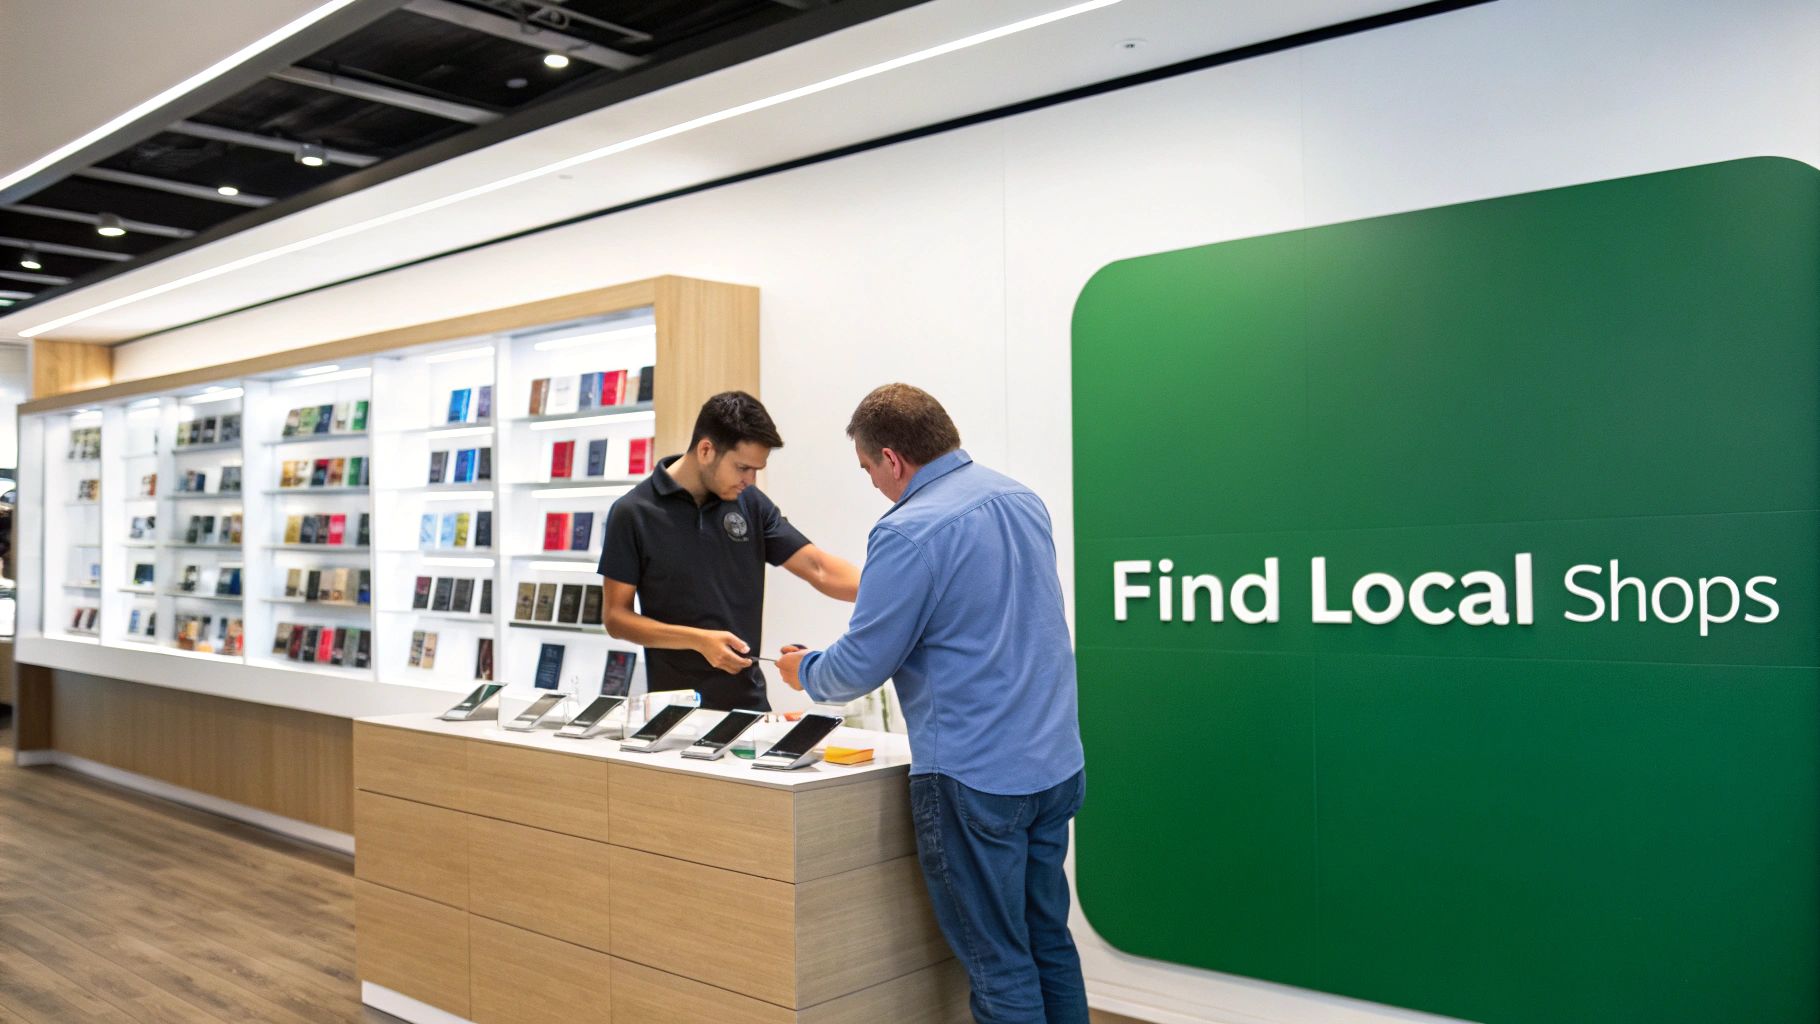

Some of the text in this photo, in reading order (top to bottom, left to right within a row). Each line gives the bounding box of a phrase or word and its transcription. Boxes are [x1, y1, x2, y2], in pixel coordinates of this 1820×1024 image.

[1112, 552, 1781, 637] Find Local Shops
